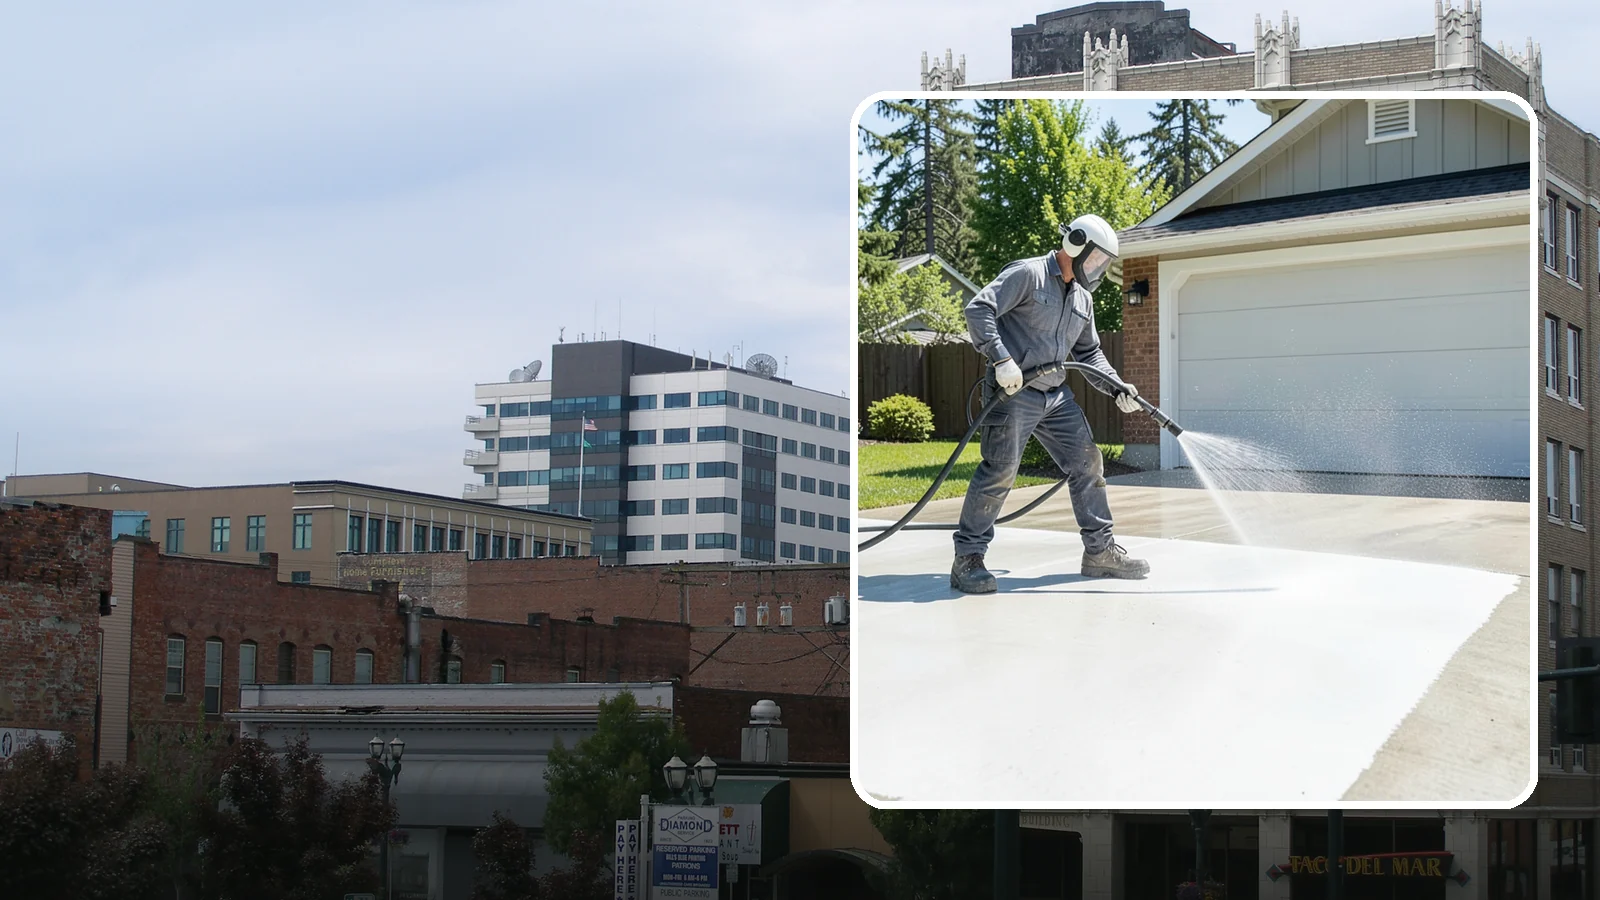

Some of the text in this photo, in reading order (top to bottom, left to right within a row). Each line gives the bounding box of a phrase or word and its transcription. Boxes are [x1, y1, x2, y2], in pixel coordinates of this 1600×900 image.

[660, 818, 713, 833] DIAMOND
[1022, 815, 1070, 828] BUILDING
[655, 845, 716, 854] RESERVED PARKING
[616, 824, 625, 894] PAY HERE
[627, 824, 637, 894] PAY HERE
[671, 862, 701, 870] PATRONS
[1344, 856, 1385, 876] DEL
[1392, 857, 1443, 877] MAR
[660, 888, 710, 899] PUBLIC PARKING
